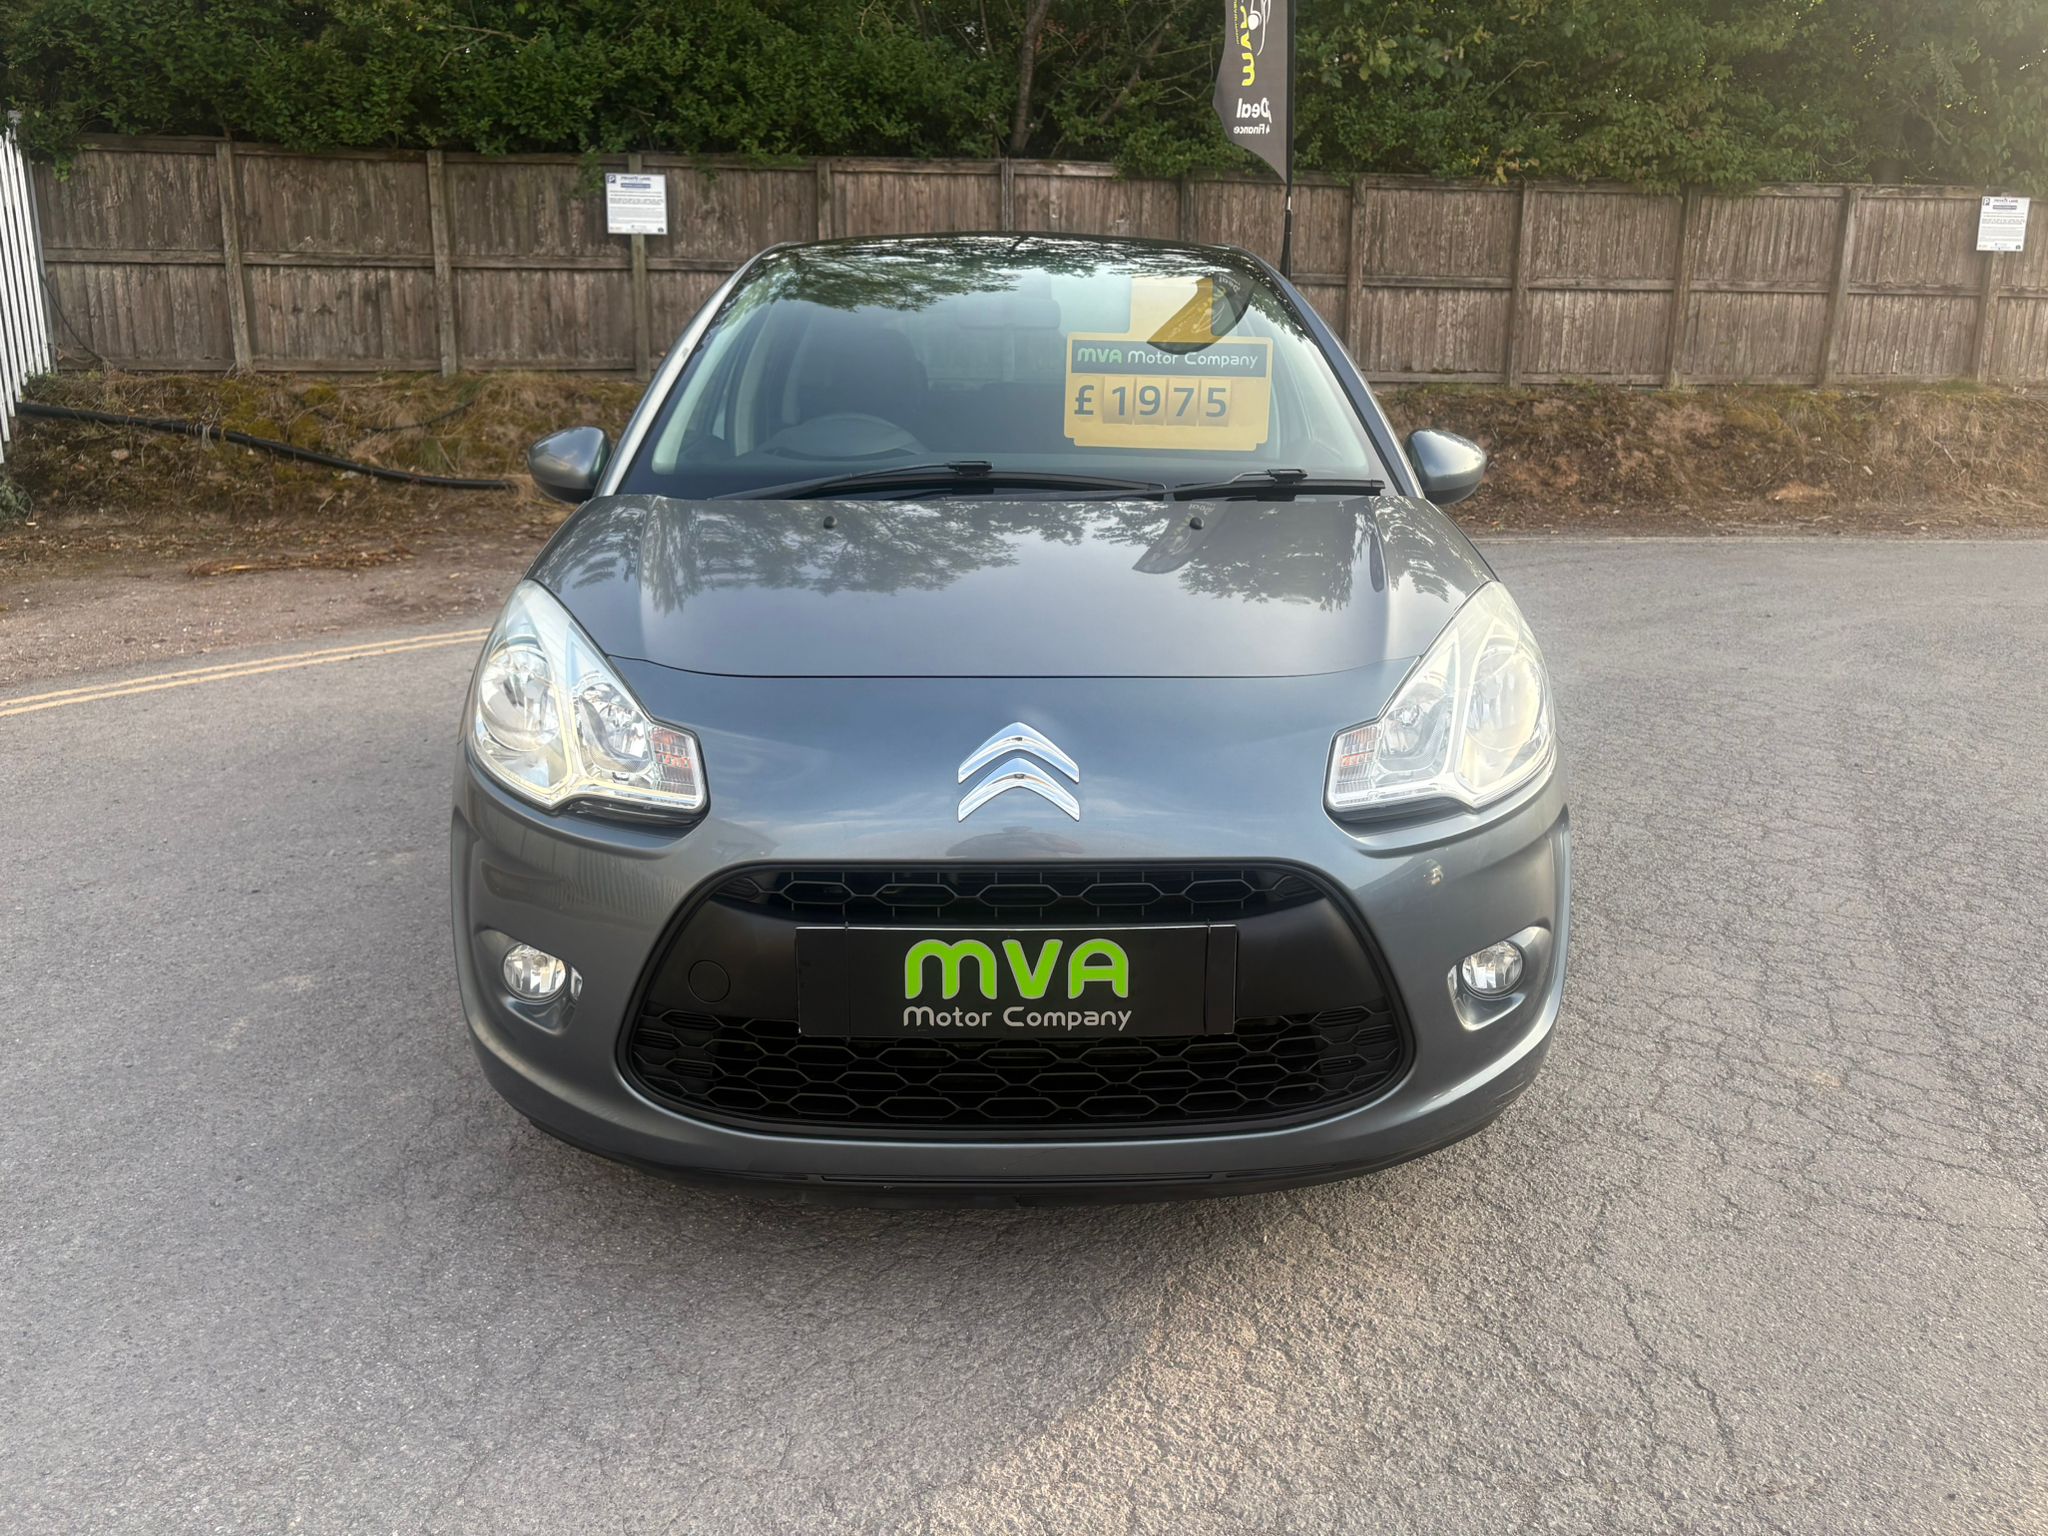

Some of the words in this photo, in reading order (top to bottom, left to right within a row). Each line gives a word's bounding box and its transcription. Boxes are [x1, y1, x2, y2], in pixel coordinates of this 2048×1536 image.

[1127, 350, 1179, 365] Motor
[1184, 351, 1259, 369] Company
[903, 1006, 993, 1027] Motor
[1003, 1006, 1132, 1032] Company
